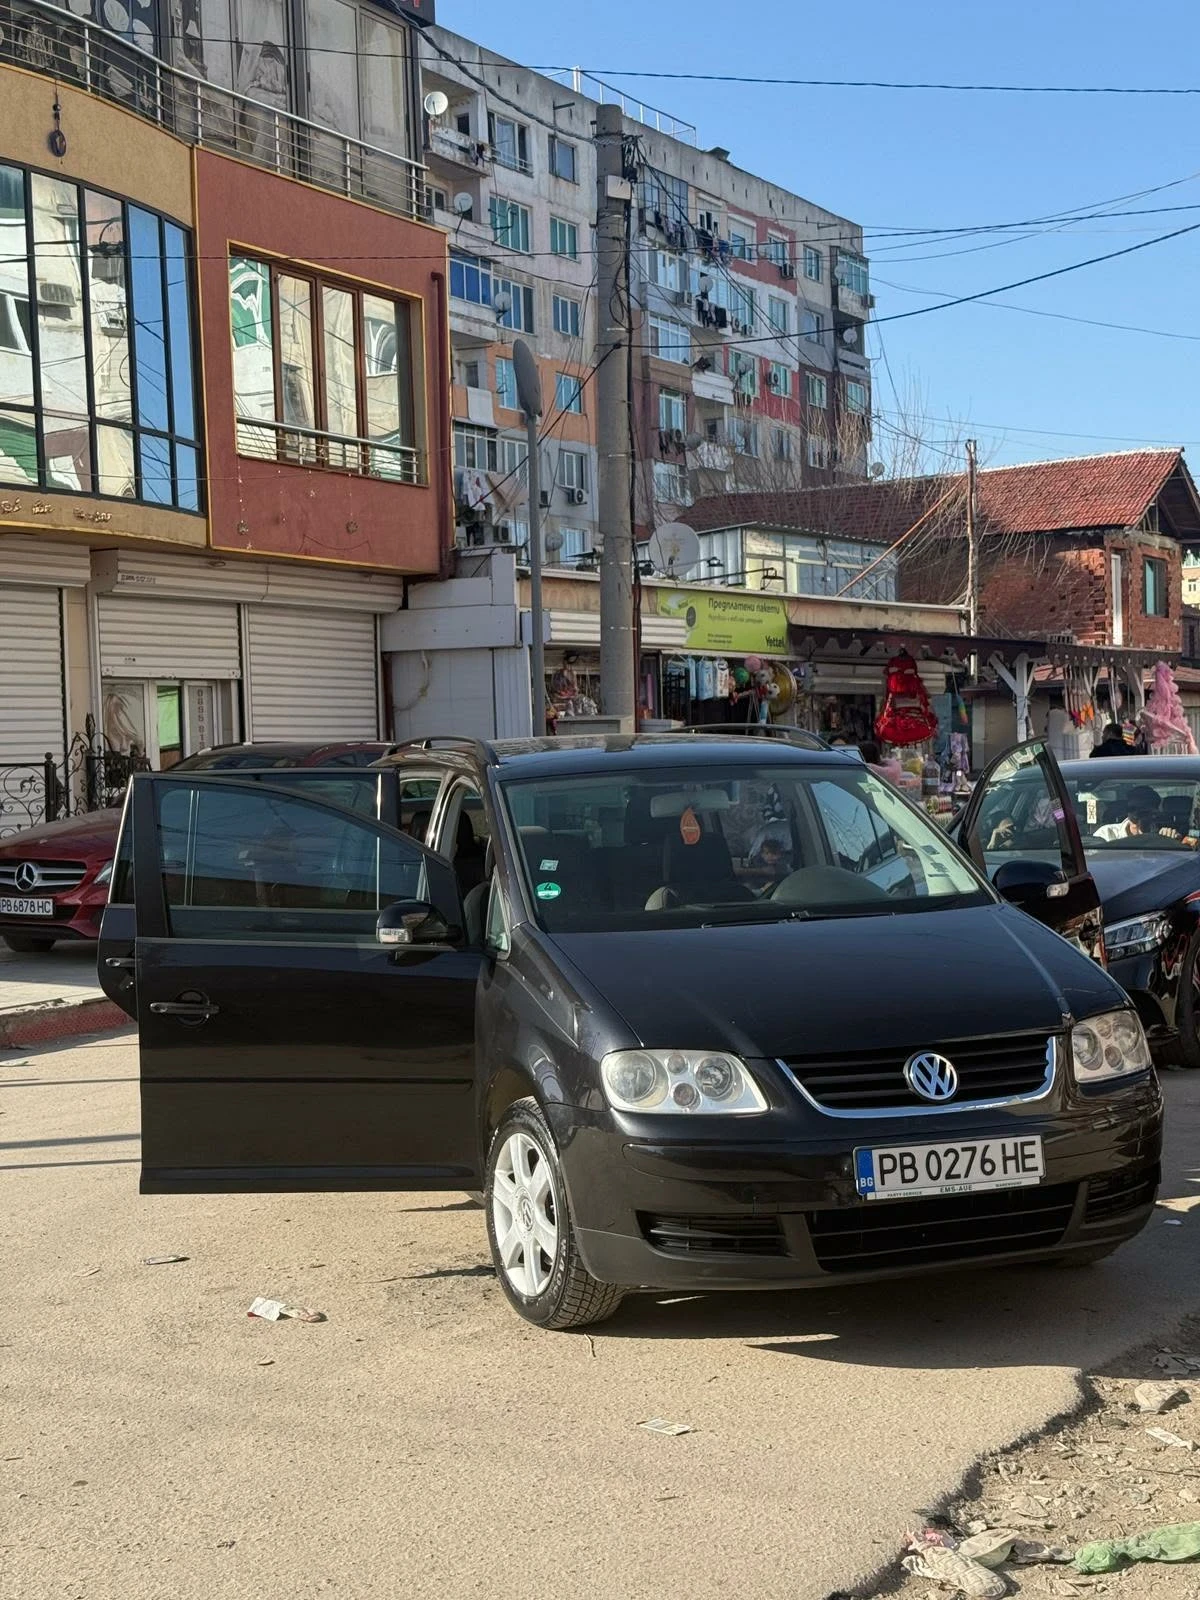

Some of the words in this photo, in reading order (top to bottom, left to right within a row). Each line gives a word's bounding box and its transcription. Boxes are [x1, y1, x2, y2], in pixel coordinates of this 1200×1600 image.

[708, 597, 755, 612] Предплатени
[765, 635, 785, 648] Yettel
[878, 1152, 919, 1186] PB
[925, 1144, 996, 1181] 0276
[1001, 1140, 1039, 1174] HE
[860, 1177, 874, 1187] BG
[940, 1184, 973, 1193] EMS-AUE
